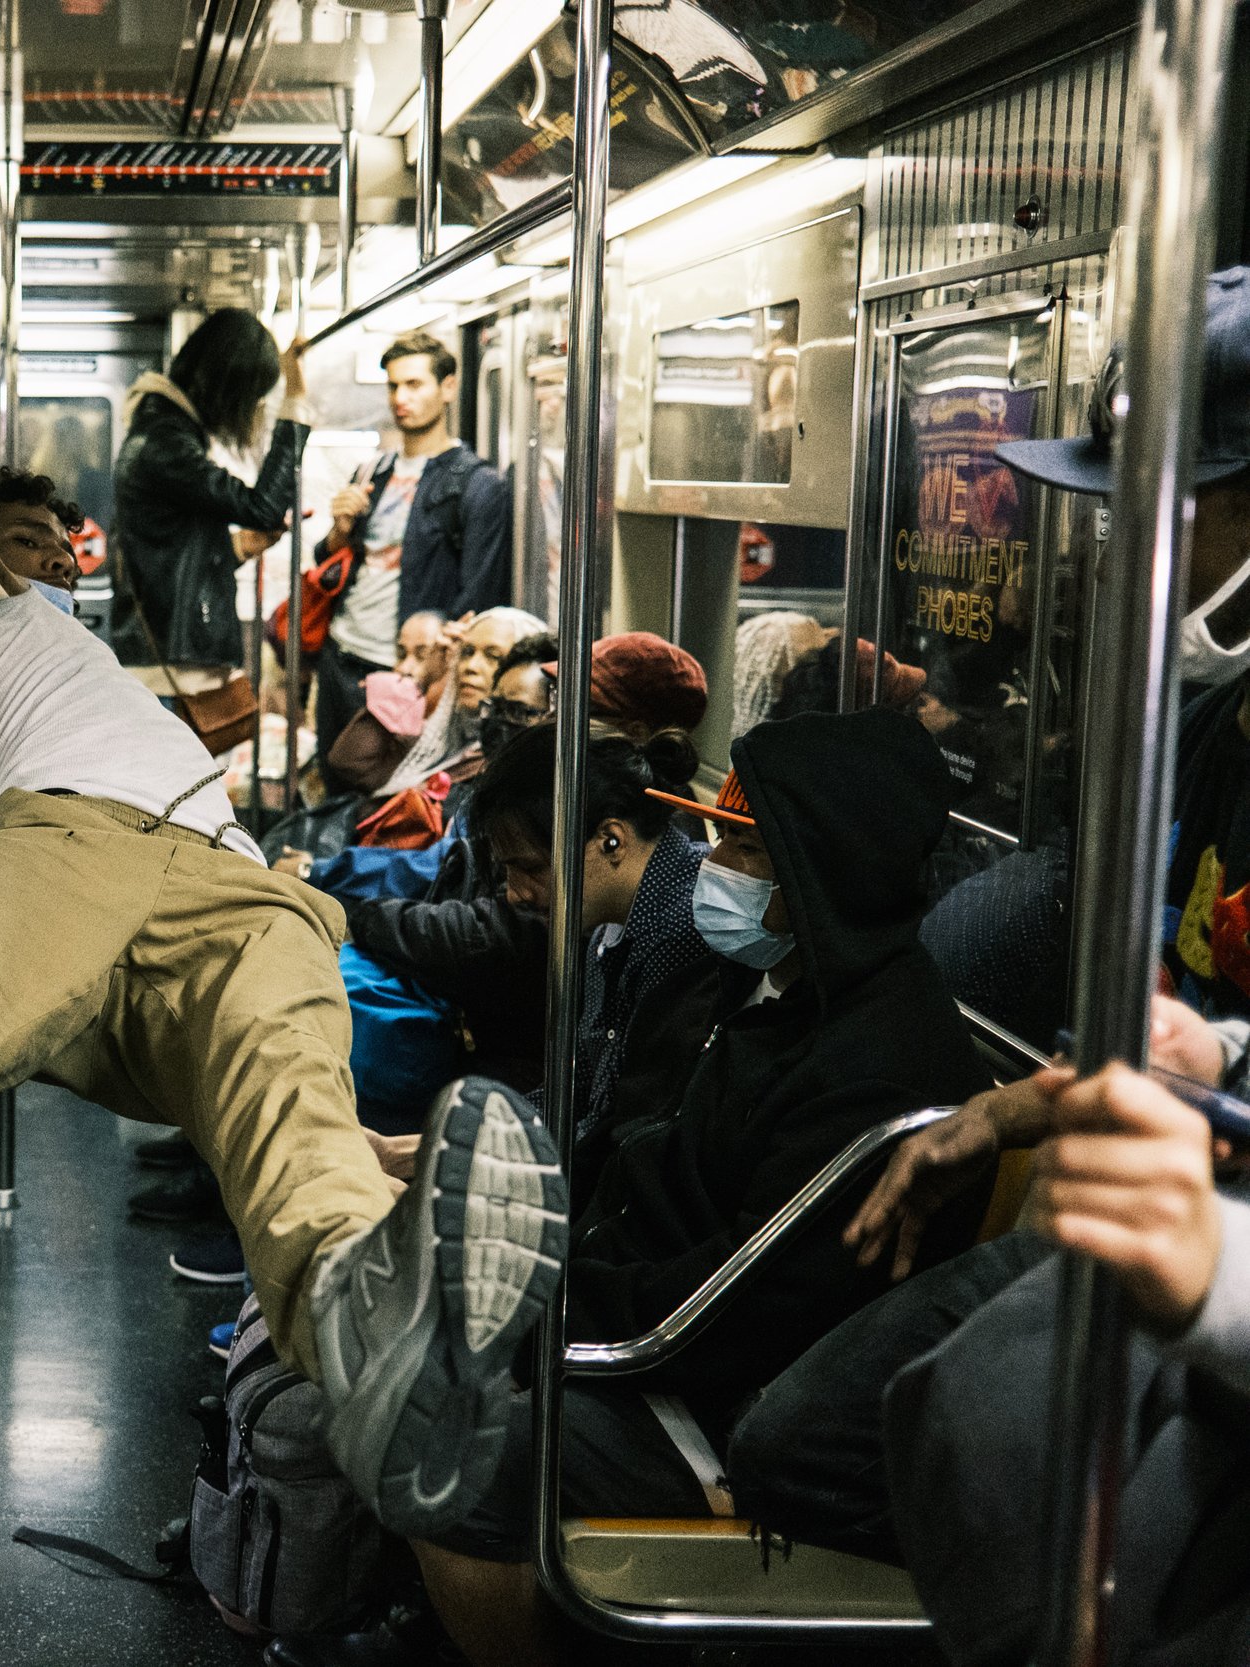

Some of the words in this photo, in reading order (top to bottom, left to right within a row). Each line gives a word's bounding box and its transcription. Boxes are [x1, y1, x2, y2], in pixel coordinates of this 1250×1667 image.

[923, 453, 970, 523] WE
[895, 529, 1029, 588] COMMITMENT
[916, 586, 993, 642] PHOBES
